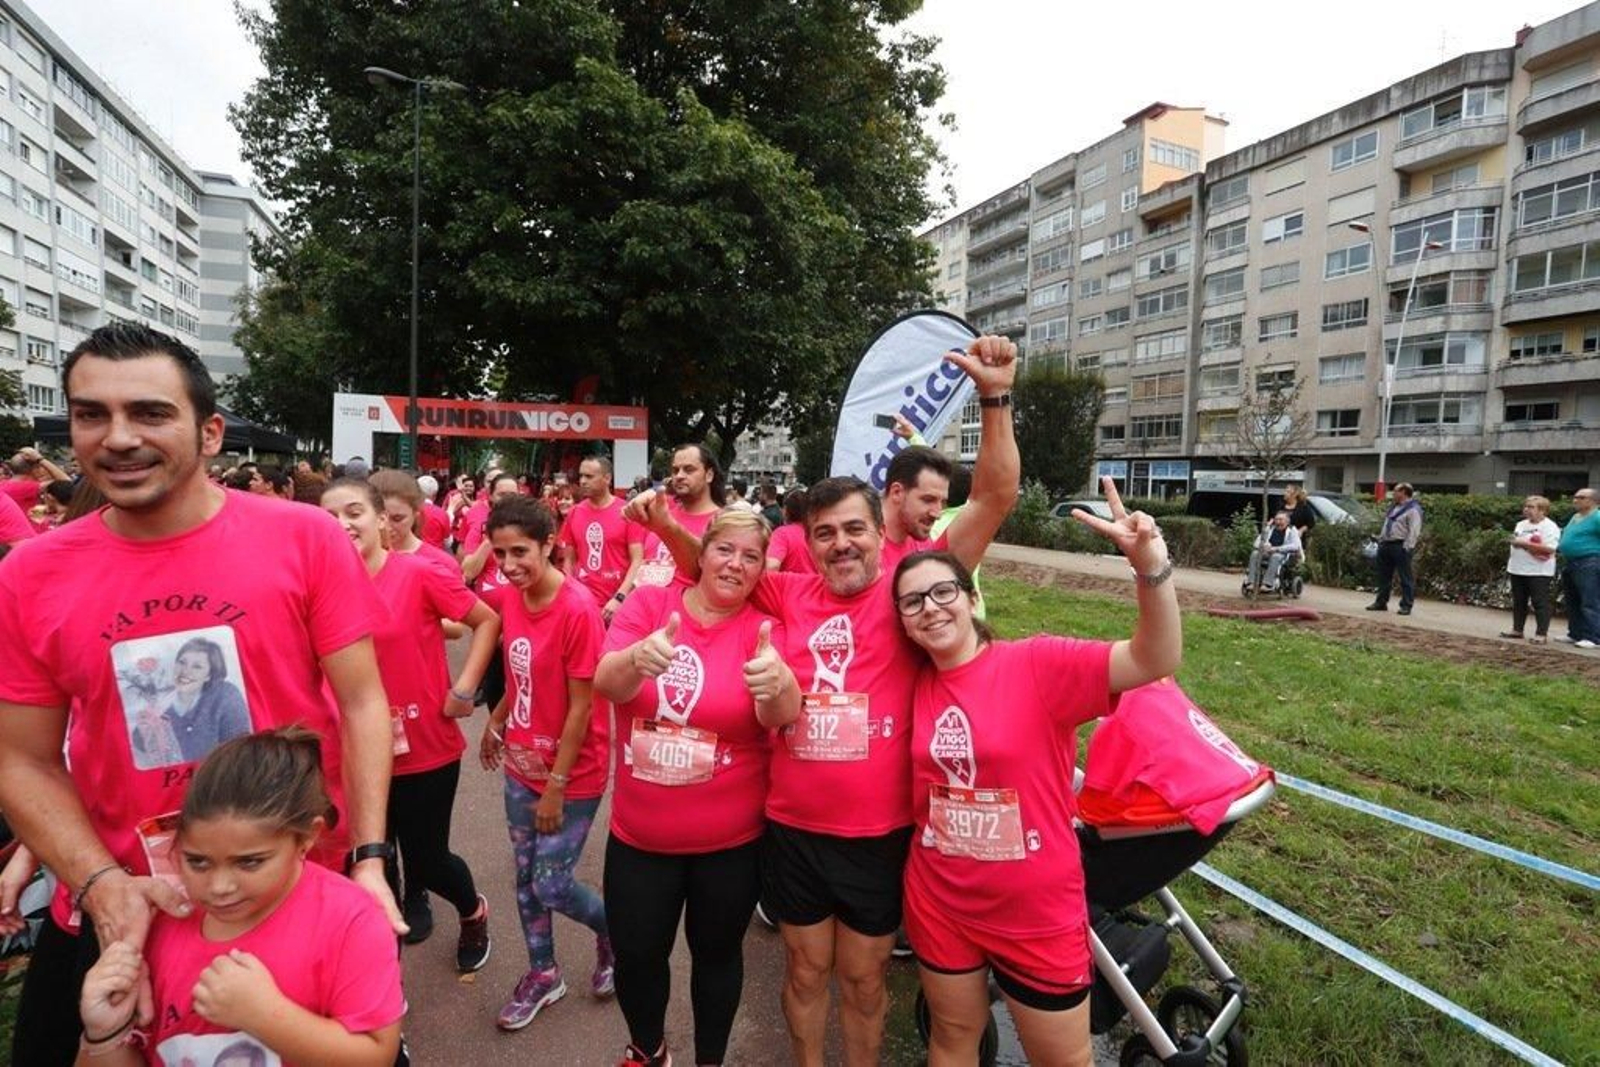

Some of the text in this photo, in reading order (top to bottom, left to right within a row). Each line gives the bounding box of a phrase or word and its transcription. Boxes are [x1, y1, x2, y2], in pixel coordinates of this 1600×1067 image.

[404, 405, 591, 432] RUNRUNVIGO
[860, 347, 967, 491] ántico
[143, 594, 208, 618] POR
[214, 601, 248, 624] TI
[807, 714, 839, 740] 312
[938, 733, 967, 745] VIGO
[649, 741, 694, 769] 4061
[162, 767, 194, 788] PA
[946, 809, 1001, 840] 3972
